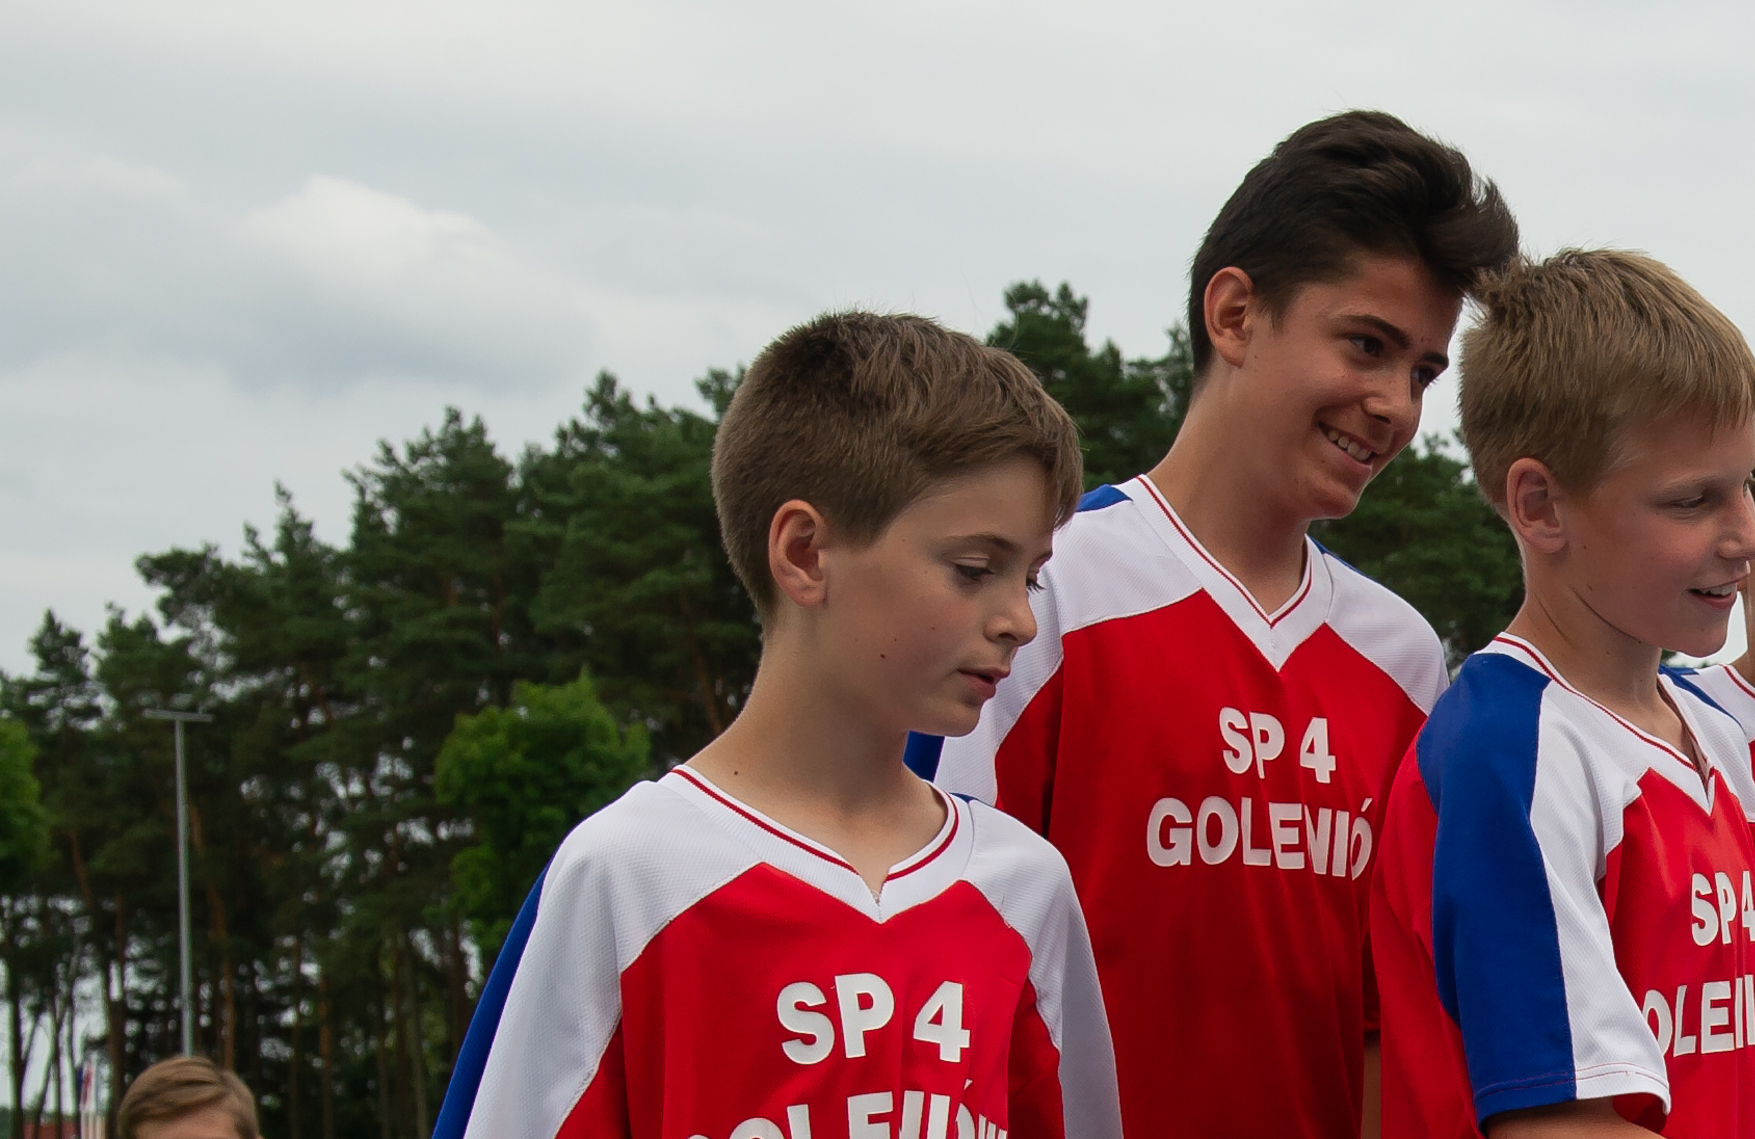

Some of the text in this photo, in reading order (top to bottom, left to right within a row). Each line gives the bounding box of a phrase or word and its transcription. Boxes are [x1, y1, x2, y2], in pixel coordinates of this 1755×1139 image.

[1218, 706, 1336, 784] SP 4
[1691, 871, 1737, 947] SP
[776, 972, 971, 1065] SP 4
